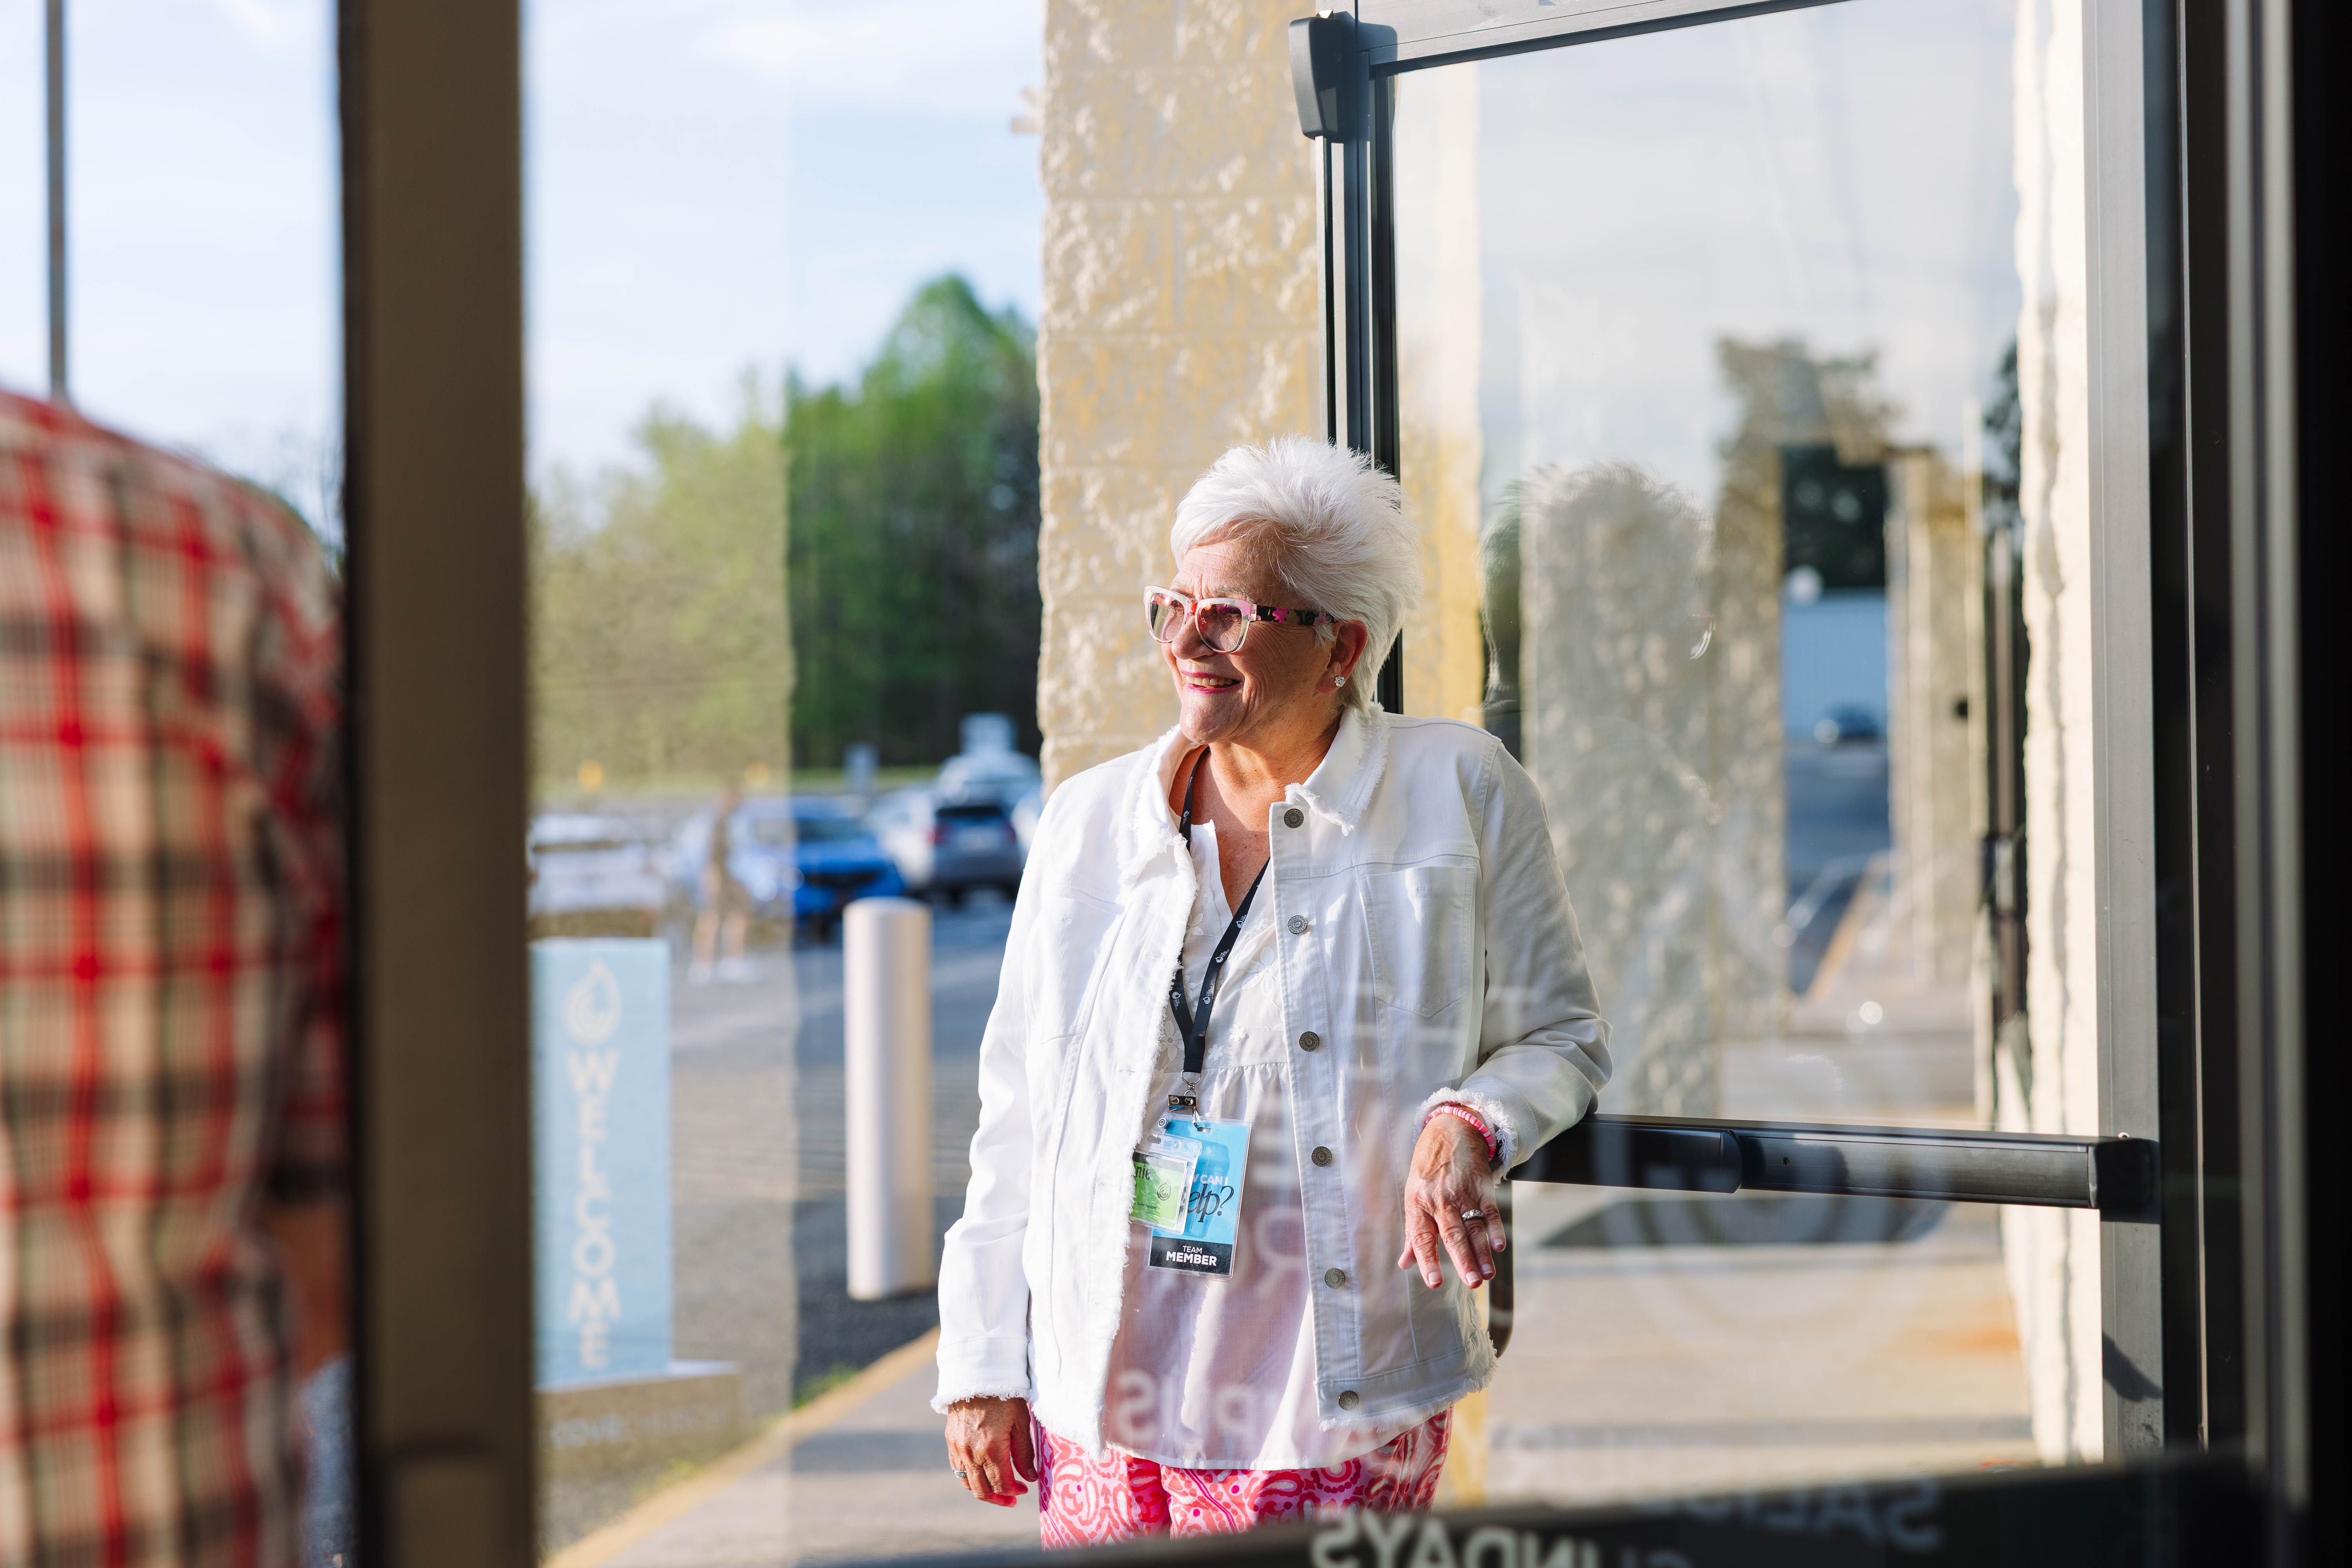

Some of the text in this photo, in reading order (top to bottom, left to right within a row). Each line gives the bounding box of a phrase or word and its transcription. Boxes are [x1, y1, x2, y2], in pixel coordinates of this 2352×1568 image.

[1200, 1174, 1223, 1185] CAN
[1224, 1176, 1228, 1186] I
[566, 1047, 622, 1369] WELCOME
[1187, 1183, 1234, 1223] elp?
[1183, 1245, 1202, 1254] TEAM
[1166, 1251, 1217, 1266] MEMBER
